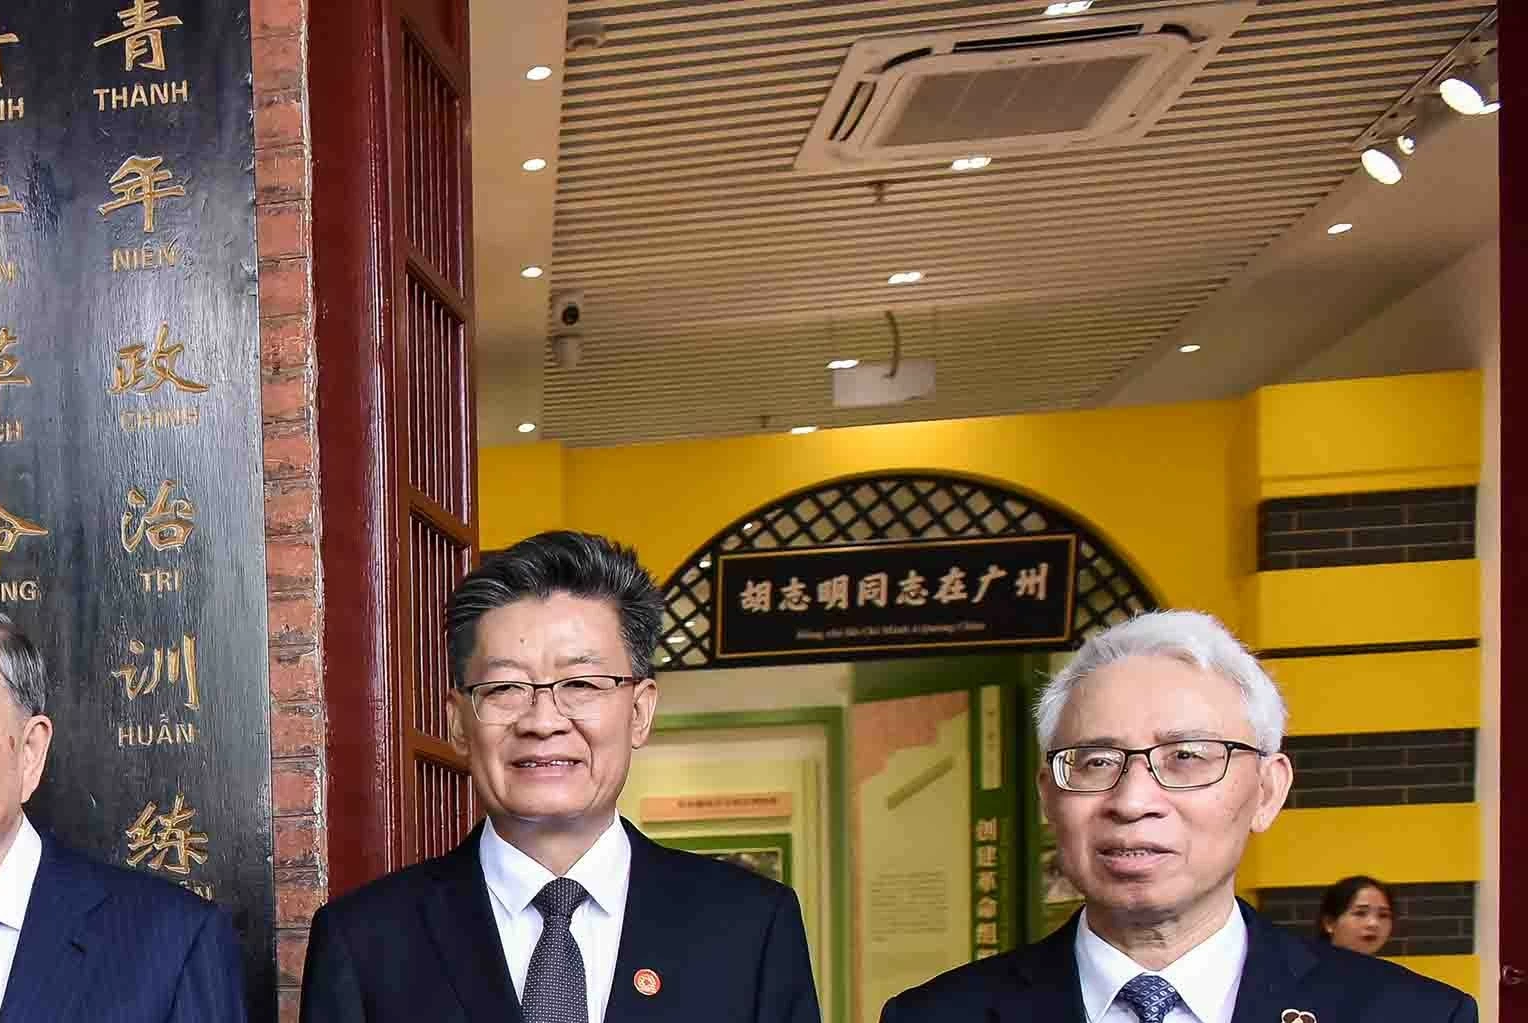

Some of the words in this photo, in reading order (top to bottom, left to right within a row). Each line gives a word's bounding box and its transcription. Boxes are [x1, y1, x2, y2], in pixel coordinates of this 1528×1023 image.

[93, 0, 184, 71] 青
[93, 80, 190, 111] THANH
[96, 155, 185, 233] 年
[108, 321, 208, 394] 政
[121, 480, 199, 552] 治
[739, 562, 1049, 613] 胡志明同志在广州
[111, 632, 200, 712] 训
